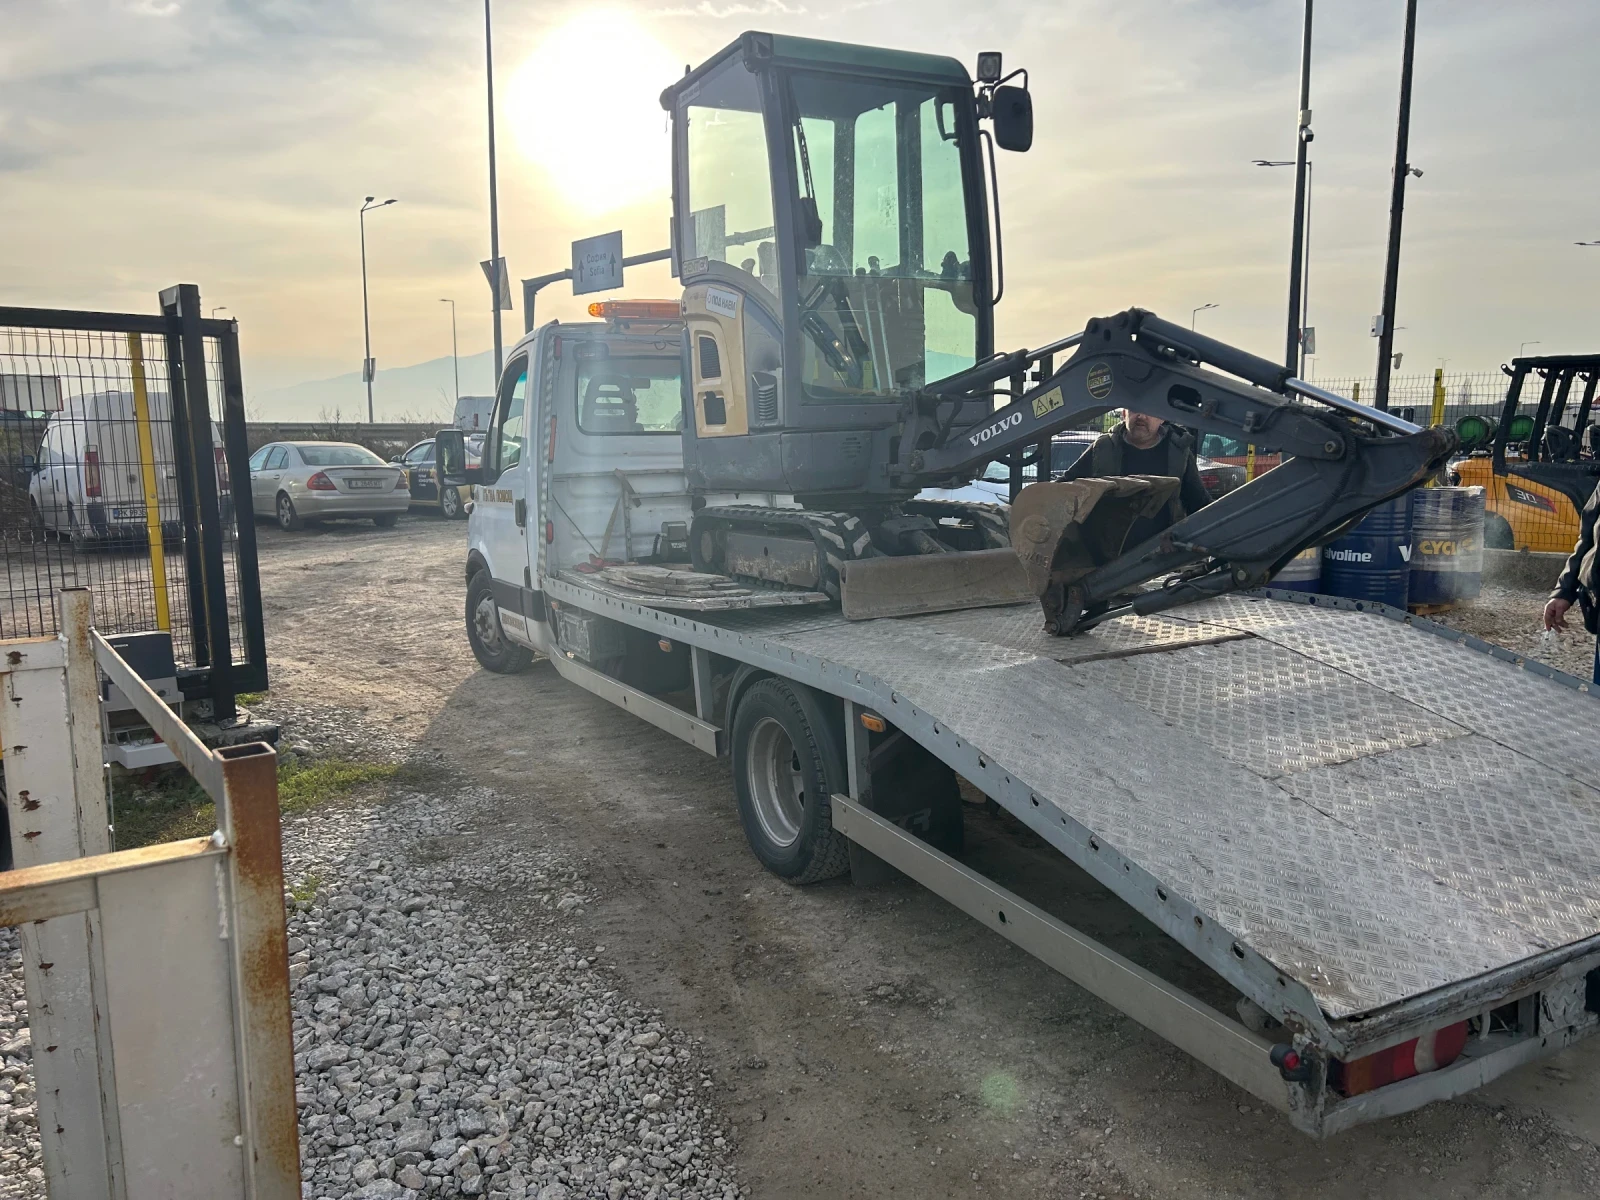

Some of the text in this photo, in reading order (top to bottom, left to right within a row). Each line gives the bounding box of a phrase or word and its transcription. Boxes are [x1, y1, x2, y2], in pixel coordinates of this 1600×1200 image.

[589, 266, 605, 277] Sofia
[968, 411, 1023, 447] VOLVO
[1324, 547, 1373, 563] alvoline
